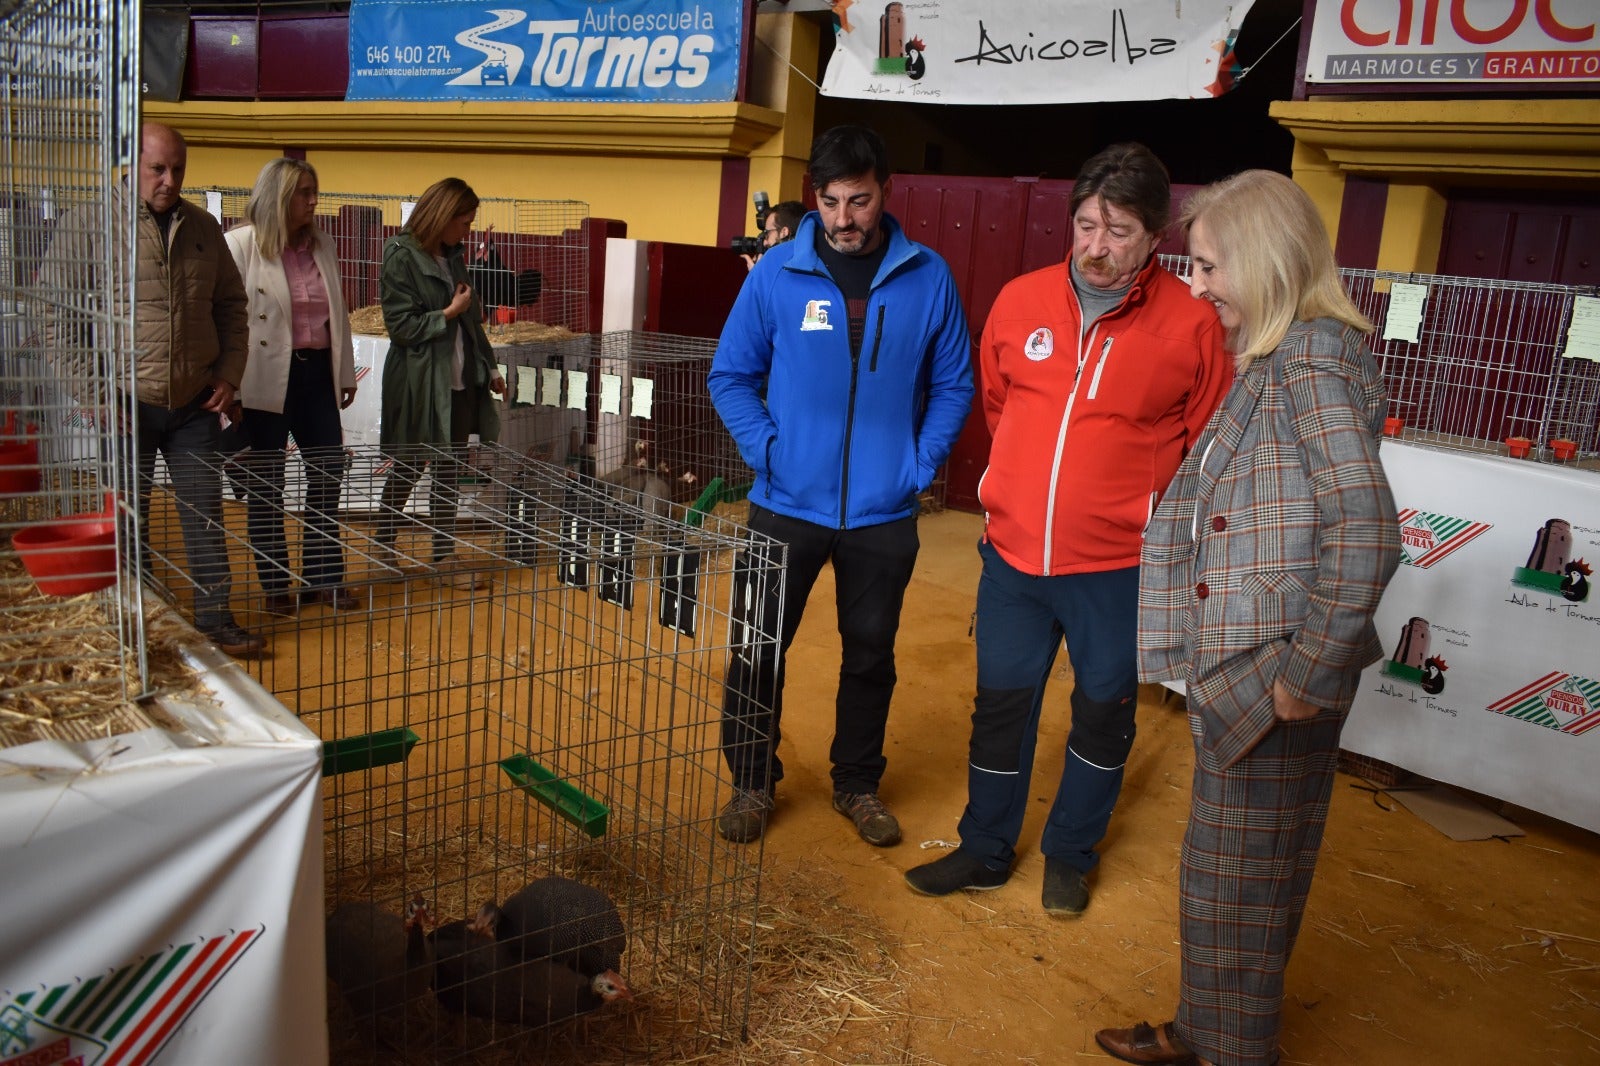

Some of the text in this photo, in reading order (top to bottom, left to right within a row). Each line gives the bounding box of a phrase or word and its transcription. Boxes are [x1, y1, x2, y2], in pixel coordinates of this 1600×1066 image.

[582, 5, 714, 32] Autoescuela
[367, 45, 451, 64] 646 400 274
[528, 19, 715, 89] Tormes
[357, 67, 462, 77] www.autoescuelatormes.com
[1332, 56, 1600, 76] MARMOLES Y GRANITO
[1403, 527, 1432, 540] PIENSOS
[1420, 696, 1457, 718] Tormes
[1546, 697, 1587, 717] DURAN
[1551, 690, 1585, 706] PIENSOS
